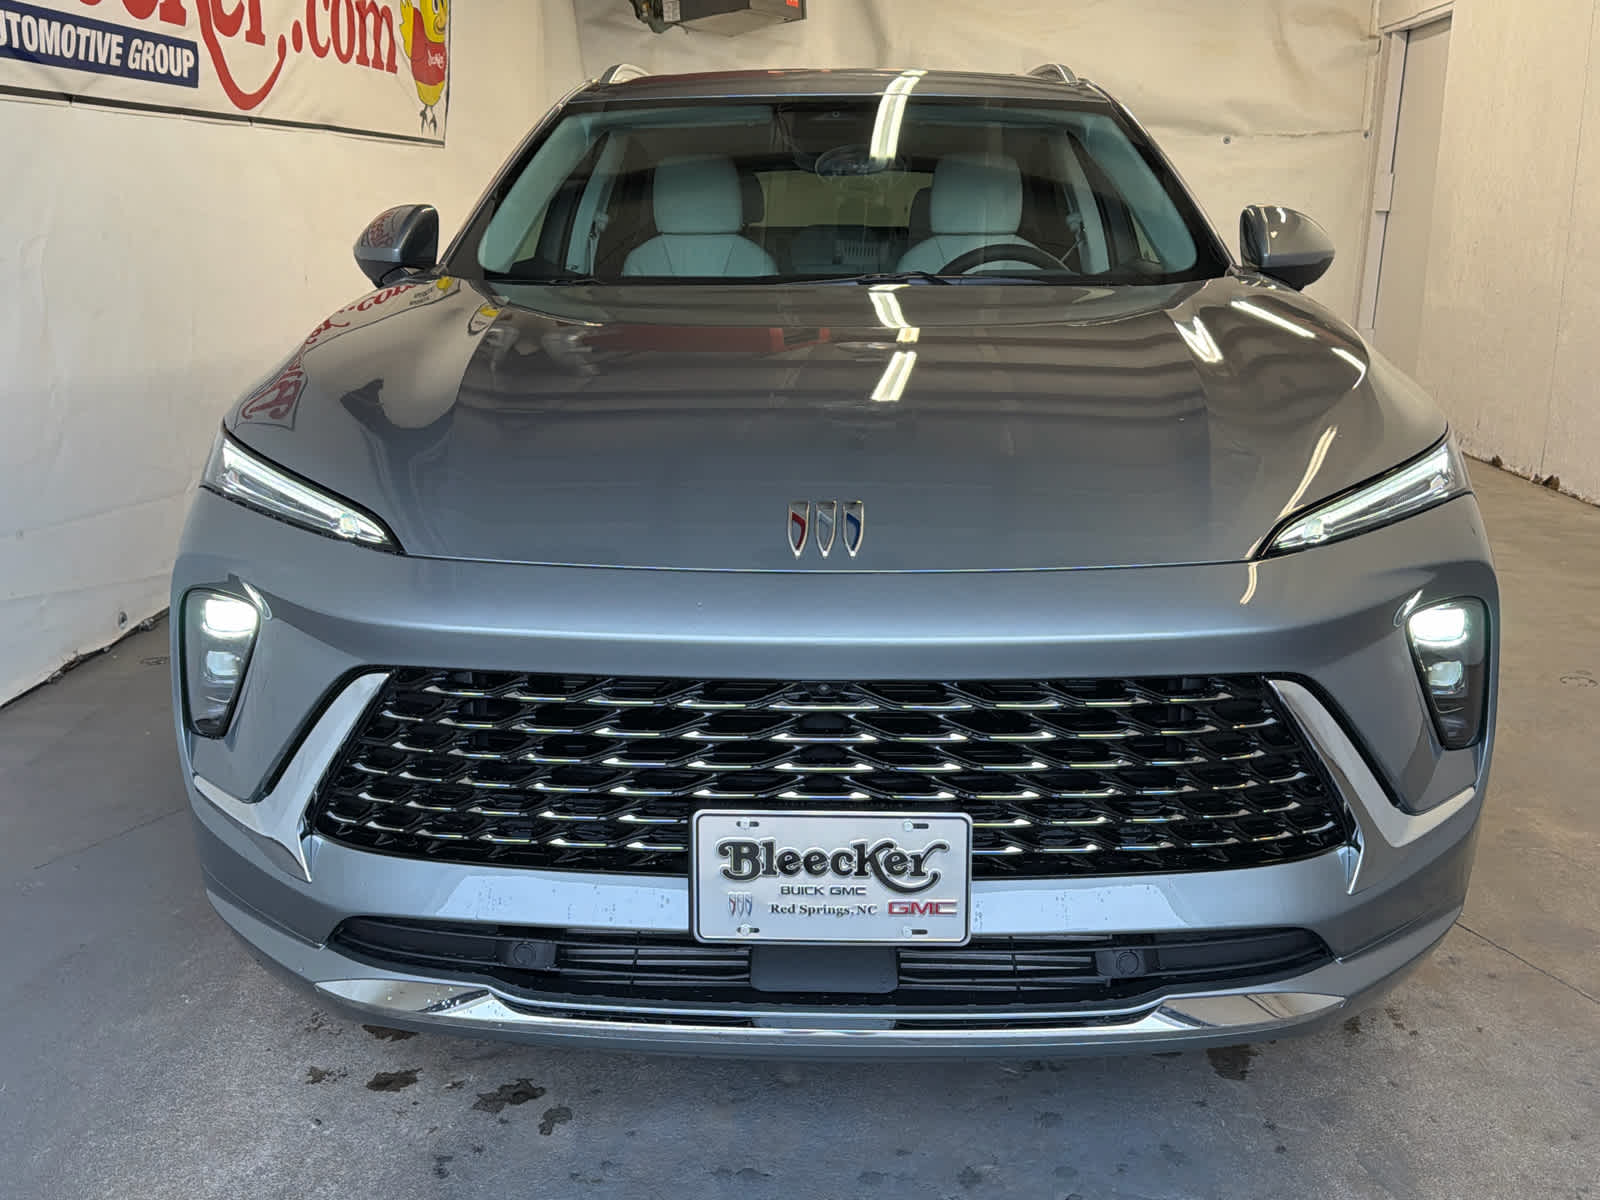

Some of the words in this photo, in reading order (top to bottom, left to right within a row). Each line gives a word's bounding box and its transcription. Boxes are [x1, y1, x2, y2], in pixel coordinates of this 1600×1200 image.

[128, 38, 195, 78] GROUP
[780, 885, 824, 896] BUICK
[829, 887, 867, 896] GMC
[770, 903, 797, 915] Red
[857, 905, 878, 915] NC
[888, 901, 958, 915] GMC
